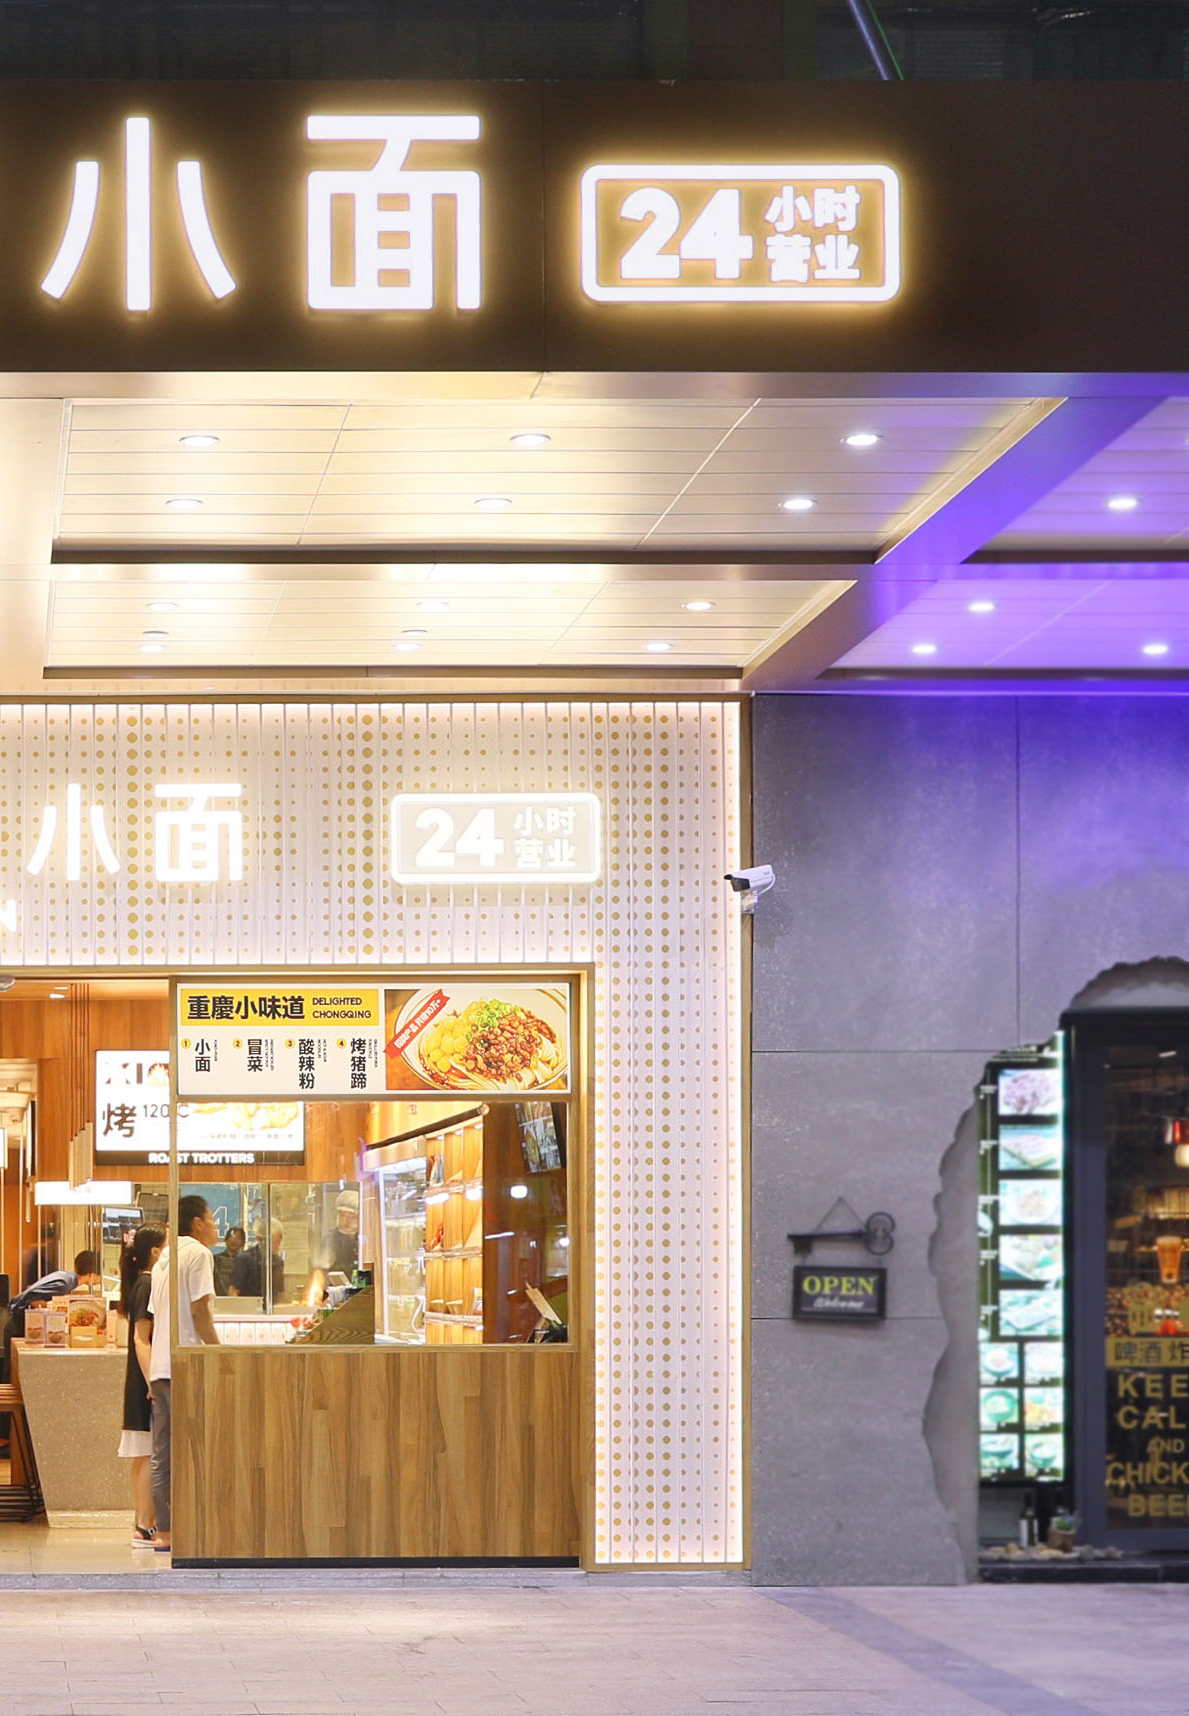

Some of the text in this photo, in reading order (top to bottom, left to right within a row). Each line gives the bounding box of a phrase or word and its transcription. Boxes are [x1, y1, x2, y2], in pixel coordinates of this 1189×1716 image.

[765, 184, 861, 232] 小时
[619, 186, 754, 279] 24
[765, 233, 861, 282] 营业
[414, 807, 505, 868] 24
[513, 806, 576, 836] 小时
[513, 838, 576, 868] 营业
[187, 995, 305, 1020] 重慶小味道
[312, 997, 362, 1006] DELIGHTED
[312, 1010, 372, 1019] CHONGQING
[194, 1038, 211, 1072] 小面
[247, 1038, 263, 1072] 冒菜
[298, 1038, 315, 1089] 酸辣粉
[350, 1038, 367, 1089] 烤猪蹄
[102, 1103, 137, 1138] 烤
[191, 1152, 255, 1164] TROTTERS
[803, 1275, 877, 1295] OPEN
